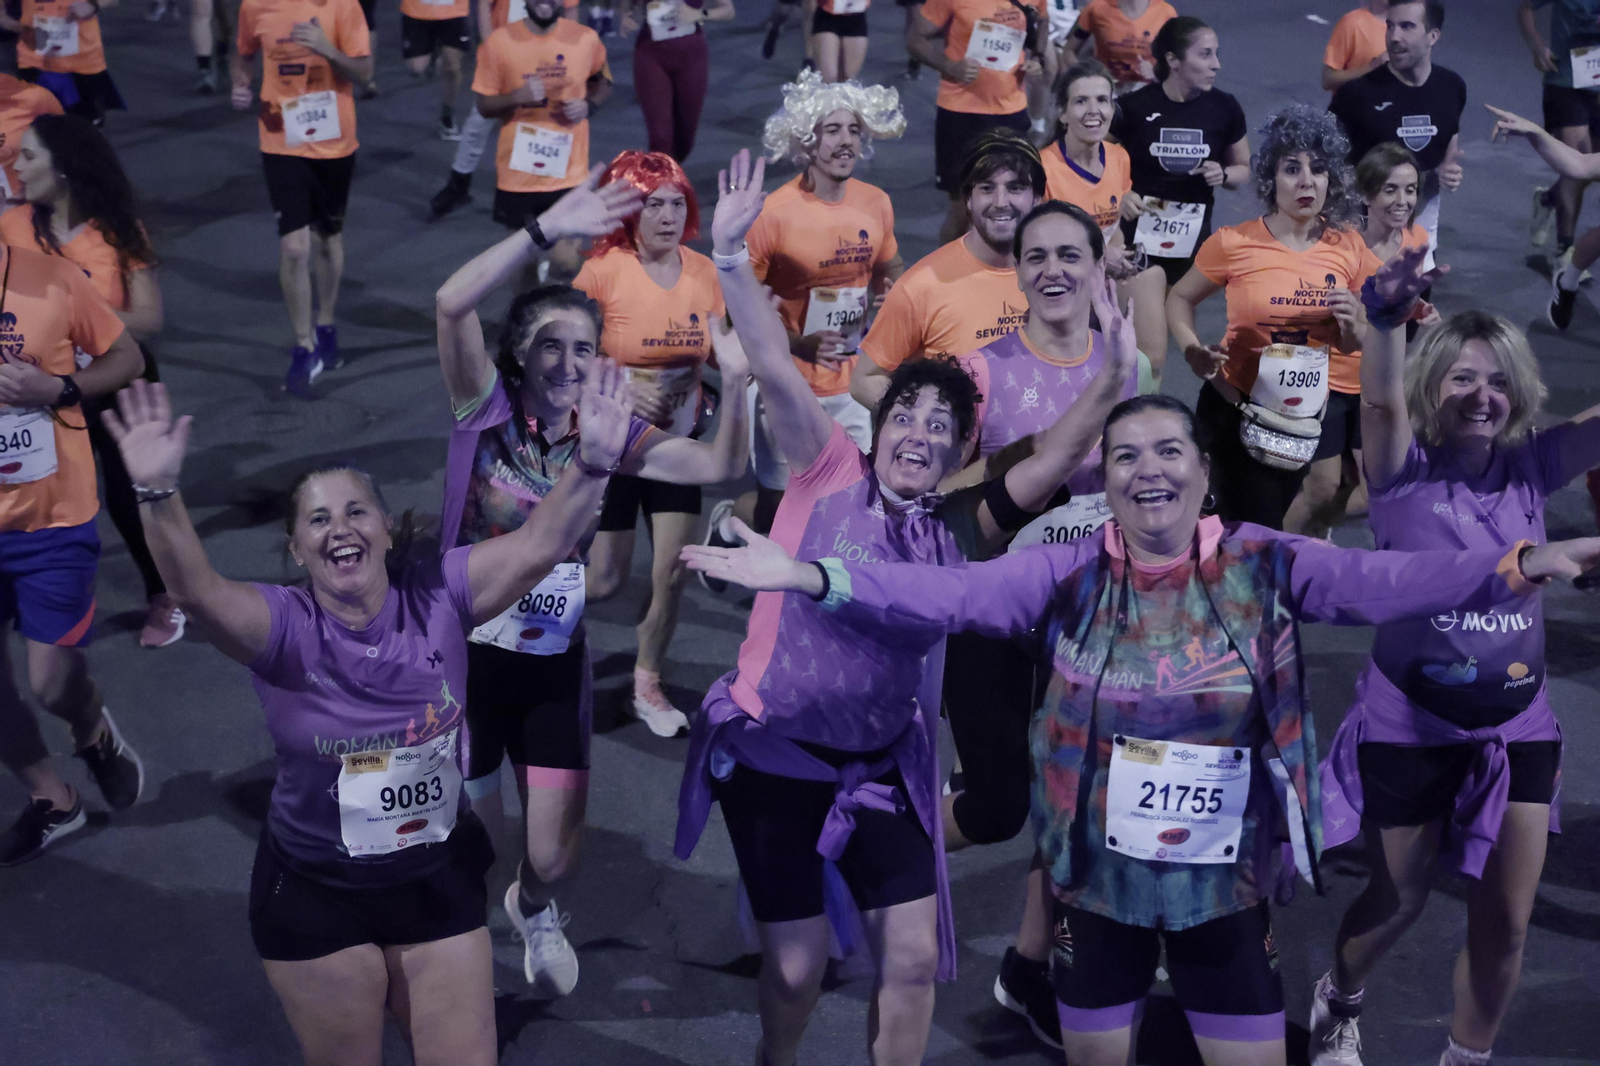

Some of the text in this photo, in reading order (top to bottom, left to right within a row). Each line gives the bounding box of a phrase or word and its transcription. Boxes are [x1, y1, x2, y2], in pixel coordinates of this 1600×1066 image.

[1172, 133, 1192, 141] CLUB
[528, 142, 560, 158] 15424
[1156, 145, 1206, 156] TRIATLÓN
[1153, 218, 1190, 236] 21671
[836, 246, 873, 256] NOCTURNA
[819, 256, 854, 268] SEVILLA
[1270, 296, 1318, 307] SEVILLA
[665, 329, 704, 338] NOCTURNA
[642, 338, 684, 347] SEVILLA
[1278, 369, 1321, 388] 13909
[518, 592, 567, 618] 8098
[314, 731, 399, 757] WOMAN
[380, 775, 443, 812] 9083
[1138, 780, 1224, 814] 21755
[1161, 832, 1185, 841] KH7
